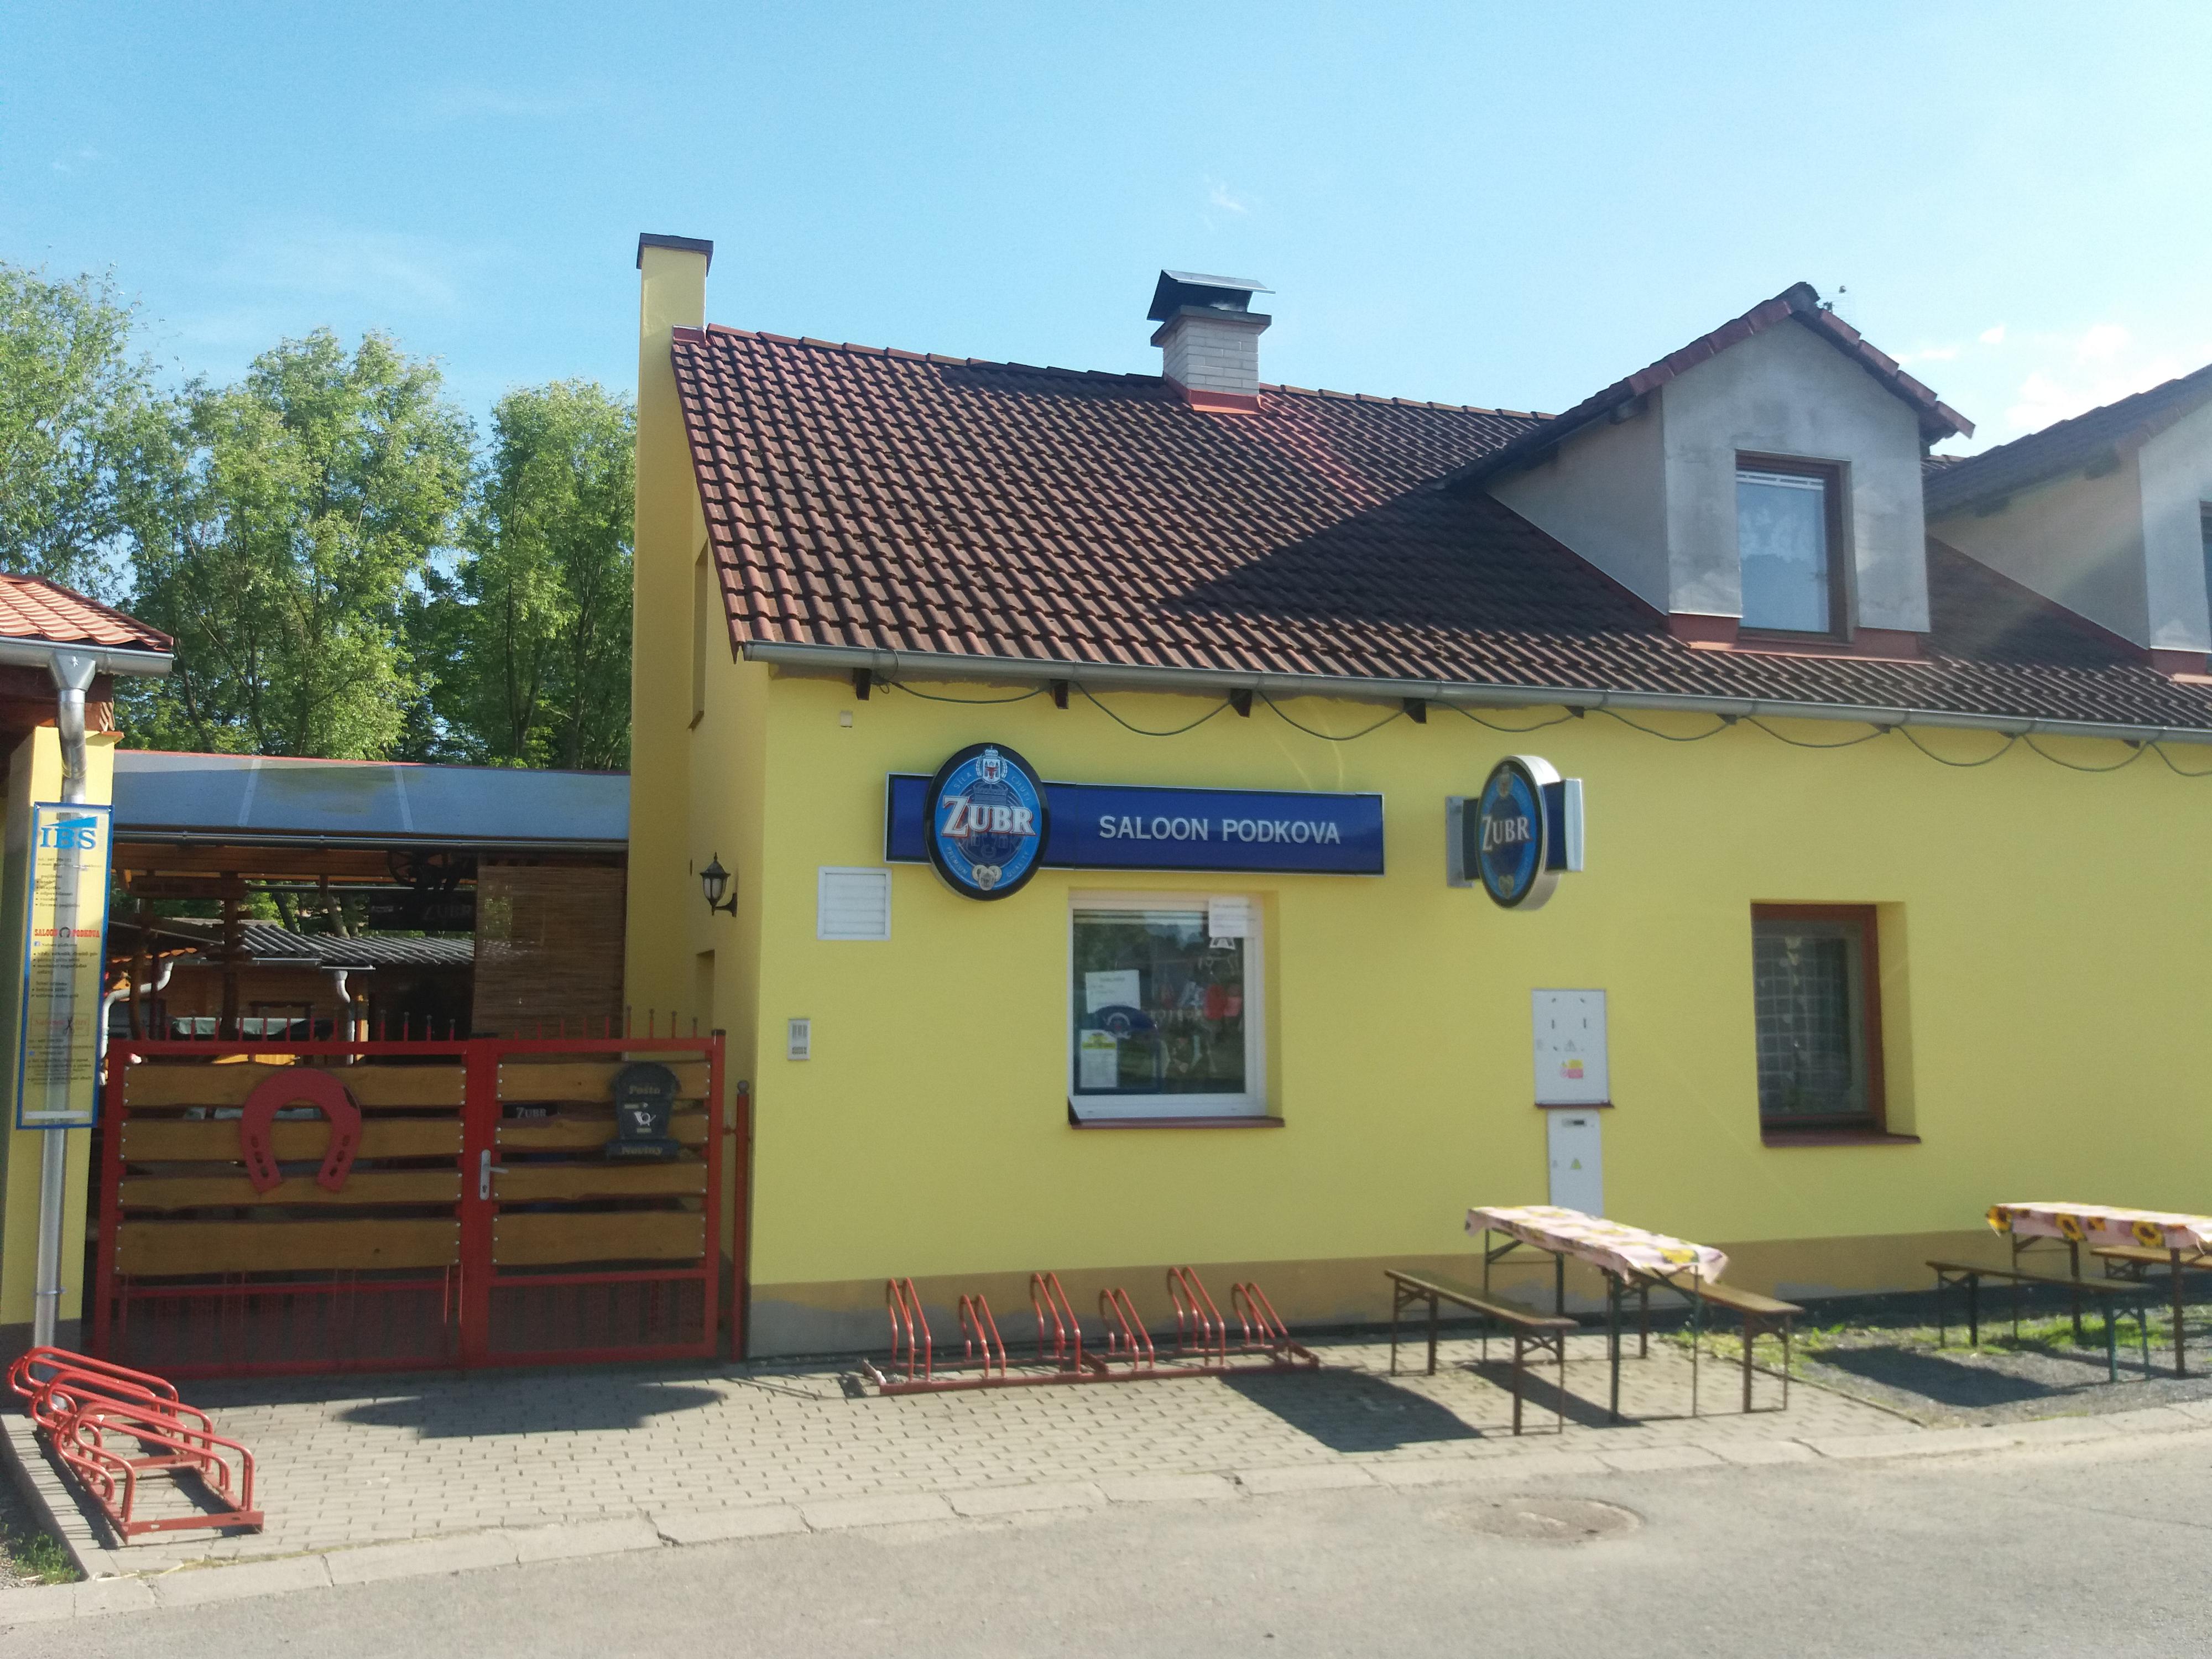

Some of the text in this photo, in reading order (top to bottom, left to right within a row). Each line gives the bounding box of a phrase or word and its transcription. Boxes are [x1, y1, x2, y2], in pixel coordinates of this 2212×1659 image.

[941, 796, 1036, 837] ZUBR
[1099, 815, 1340, 844] SALOON PODKOVA
[40, 827, 96, 849] IBS
[1481, 815, 1531, 851] ZUBR
[34, 928, 100, 938] SALOON PODKOVA
